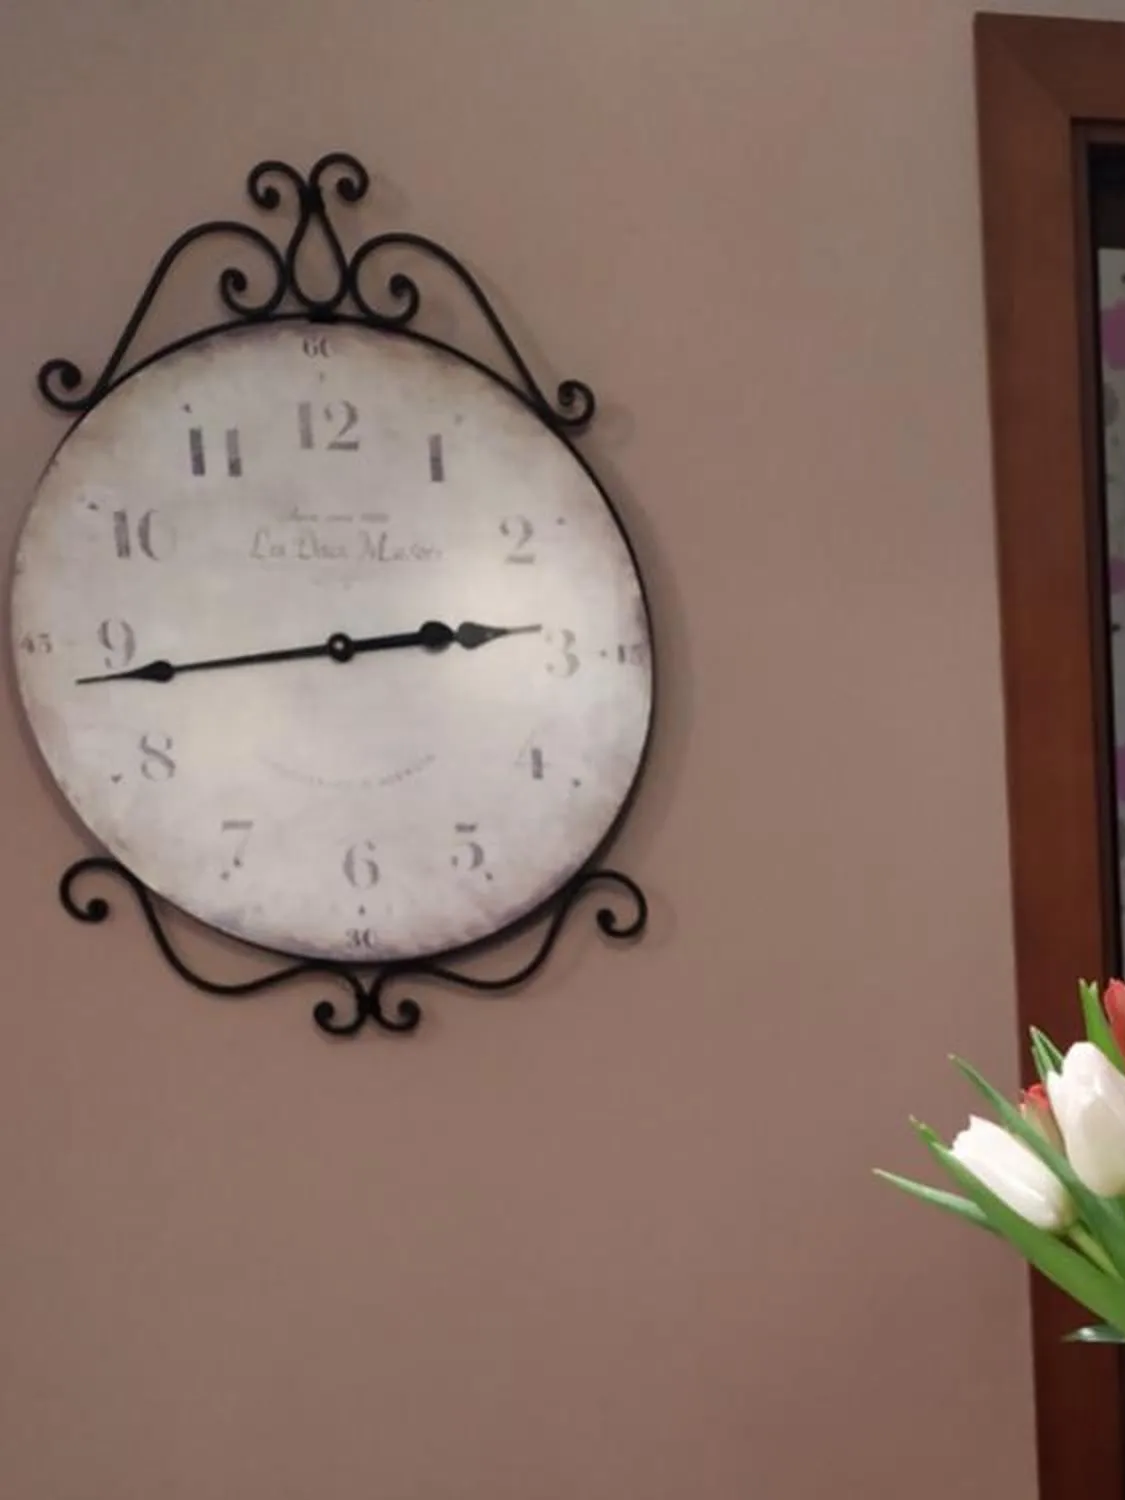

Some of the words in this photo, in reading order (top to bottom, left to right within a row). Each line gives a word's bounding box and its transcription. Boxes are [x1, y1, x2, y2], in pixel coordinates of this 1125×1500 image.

[298, 400, 359, 450] 12
[189, 427, 242, 477] 11
[428, 434, 444, 482] 1
[113, 508, 177, 561] 10
[500, 515, 535, 564] 2
[97, 618, 135, 670] 9
[544, 628, 580, 678] 3
[140, 734, 176, 783] 8
[221, 820, 253, 867] 7
[343, 840, 379, 889] 6
[451, 822, 485, 870] 5
